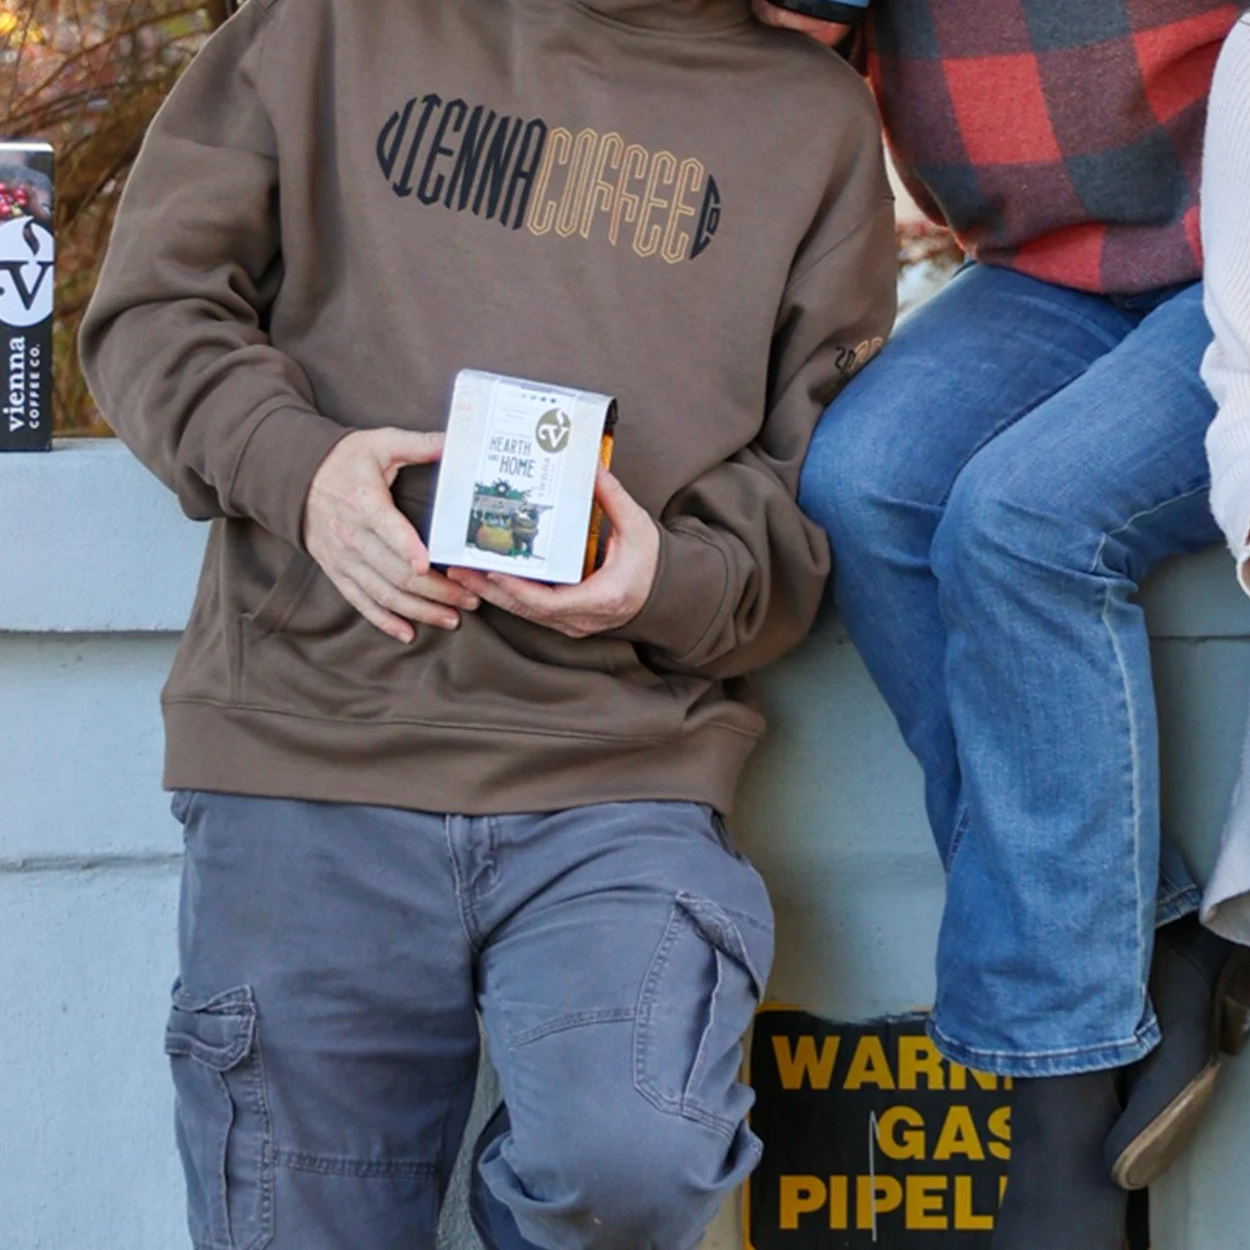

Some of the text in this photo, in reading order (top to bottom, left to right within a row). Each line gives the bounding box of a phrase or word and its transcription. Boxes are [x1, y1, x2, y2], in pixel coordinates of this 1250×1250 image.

[376, 93, 548, 230] VIENNA
[527, 127, 704, 264] COFFEE
[2, 336, 26, 432] vienna
[29, 343, 41, 430] COFFEE CO.
[489, 437, 532, 456] HEARTH
[499, 456, 537, 479] HOME
[771, 1035, 1013, 1090] WAR
[779, 1175, 1008, 1230] PIPEL
